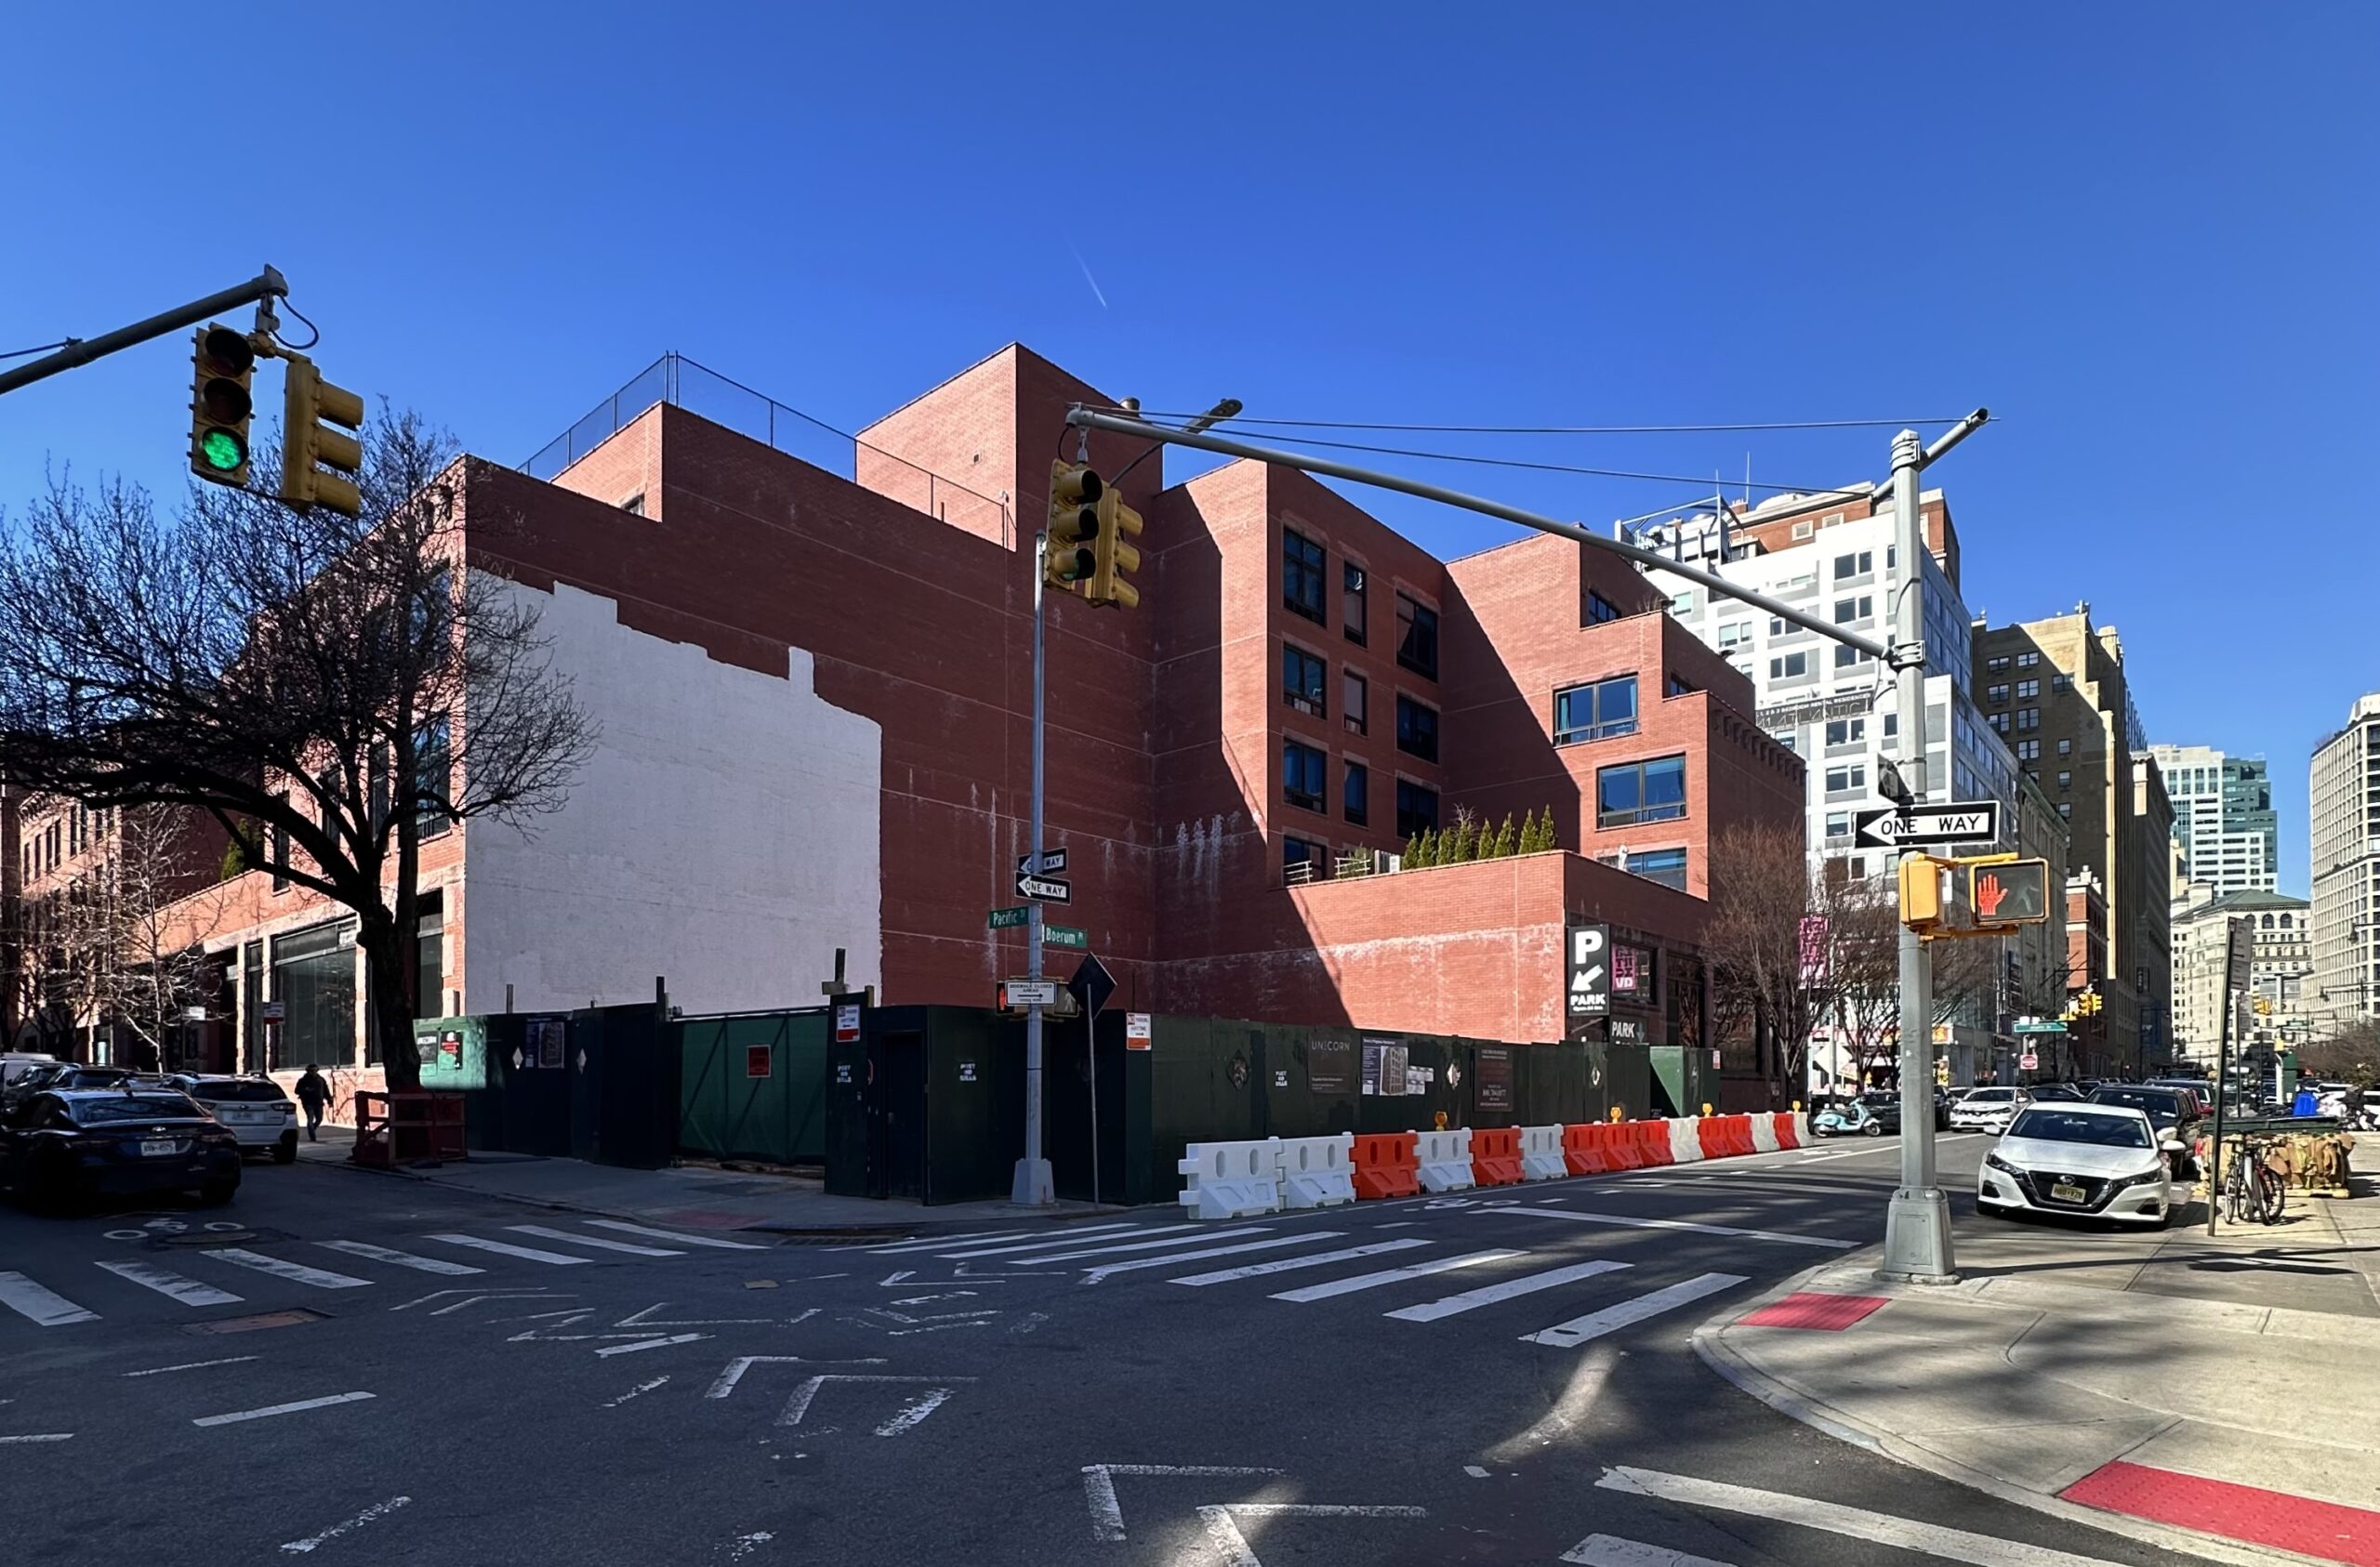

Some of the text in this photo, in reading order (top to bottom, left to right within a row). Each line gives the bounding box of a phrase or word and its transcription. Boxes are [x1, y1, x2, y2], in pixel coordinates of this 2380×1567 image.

[1881, 815, 1980, 836] ONE WAY
[1045, 857, 1061, 868] WAY
[1025, 881, 1063, 897] ONE WAY
[993, 911, 1018, 926] Pacific
[1046, 927, 1076, 945] Boerum
[1575, 930, 1603, 965] P
[1570, 994, 1606, 1006] PARK
[1611, 1021, 1635, 1039] PARK
[1311, 1040, 1351, 1051] UNICORN
